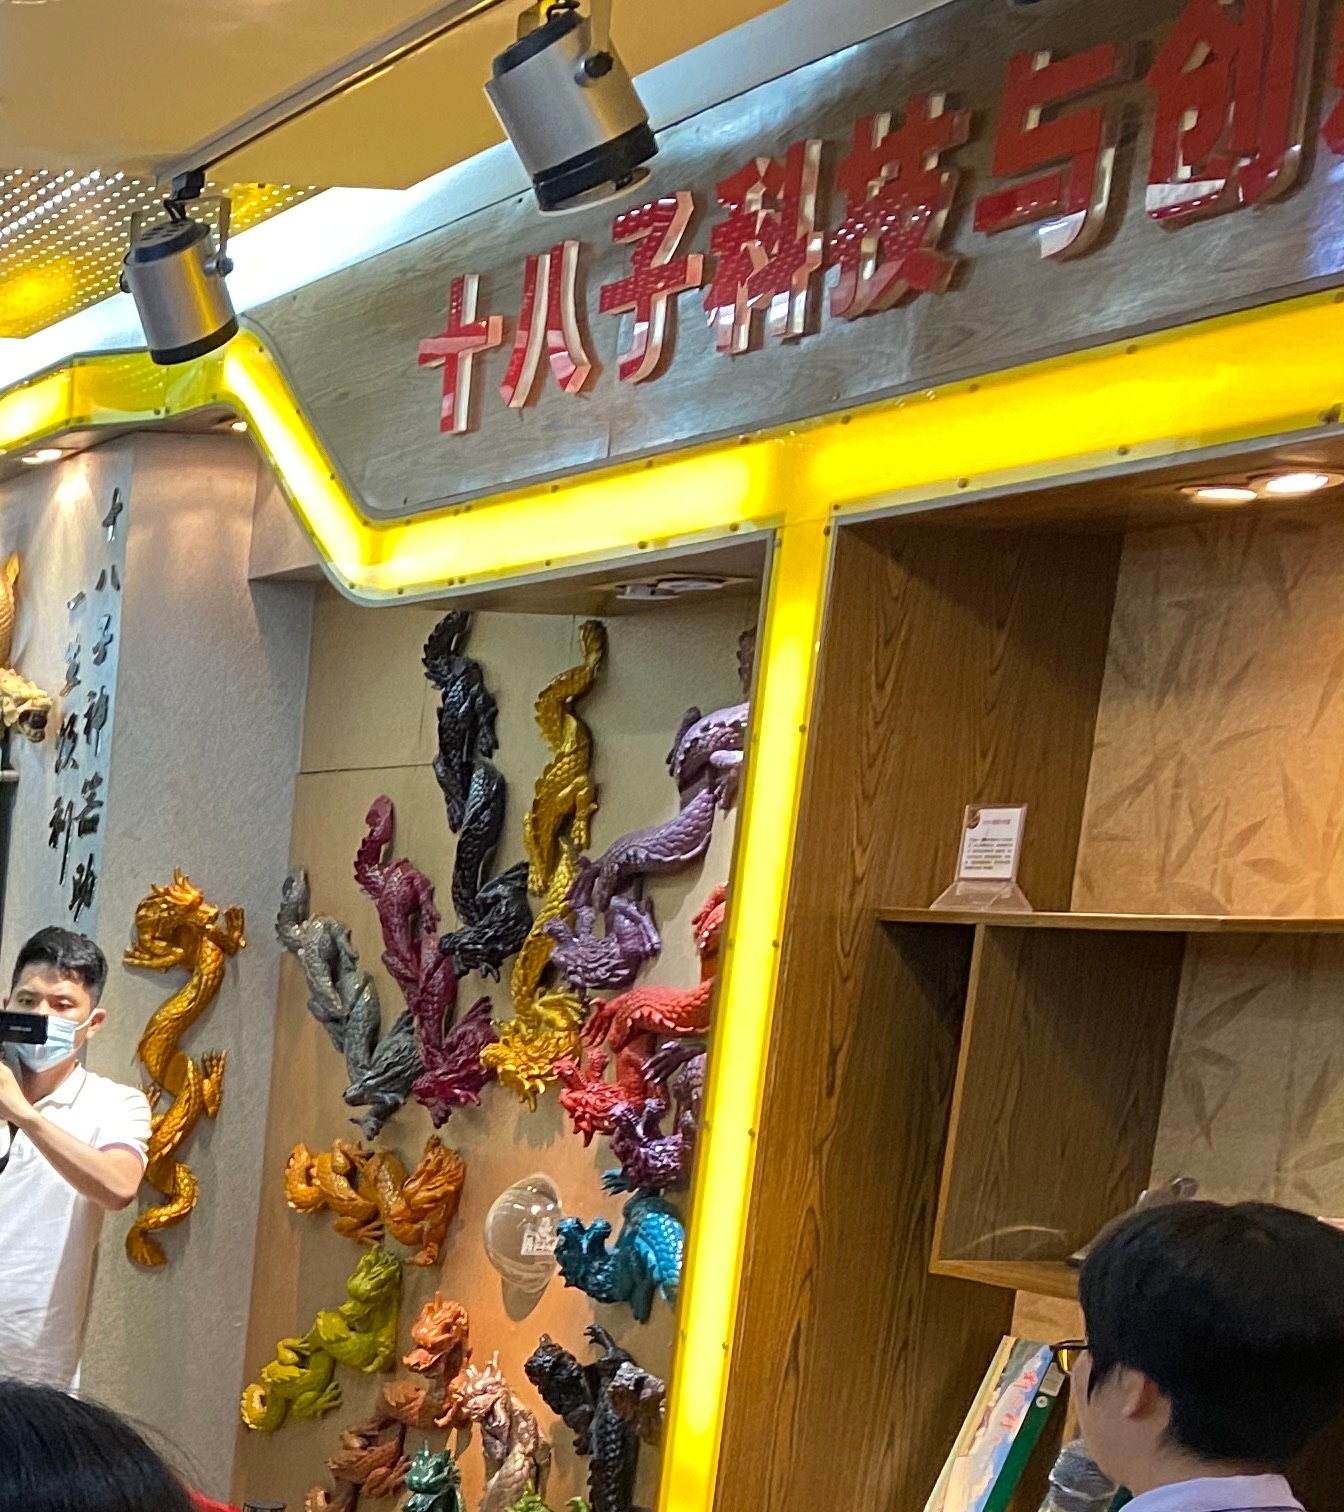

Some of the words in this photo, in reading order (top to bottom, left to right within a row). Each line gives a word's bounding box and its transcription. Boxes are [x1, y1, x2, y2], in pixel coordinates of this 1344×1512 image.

[418, 0, 1344, 434] 十八子科技与创
